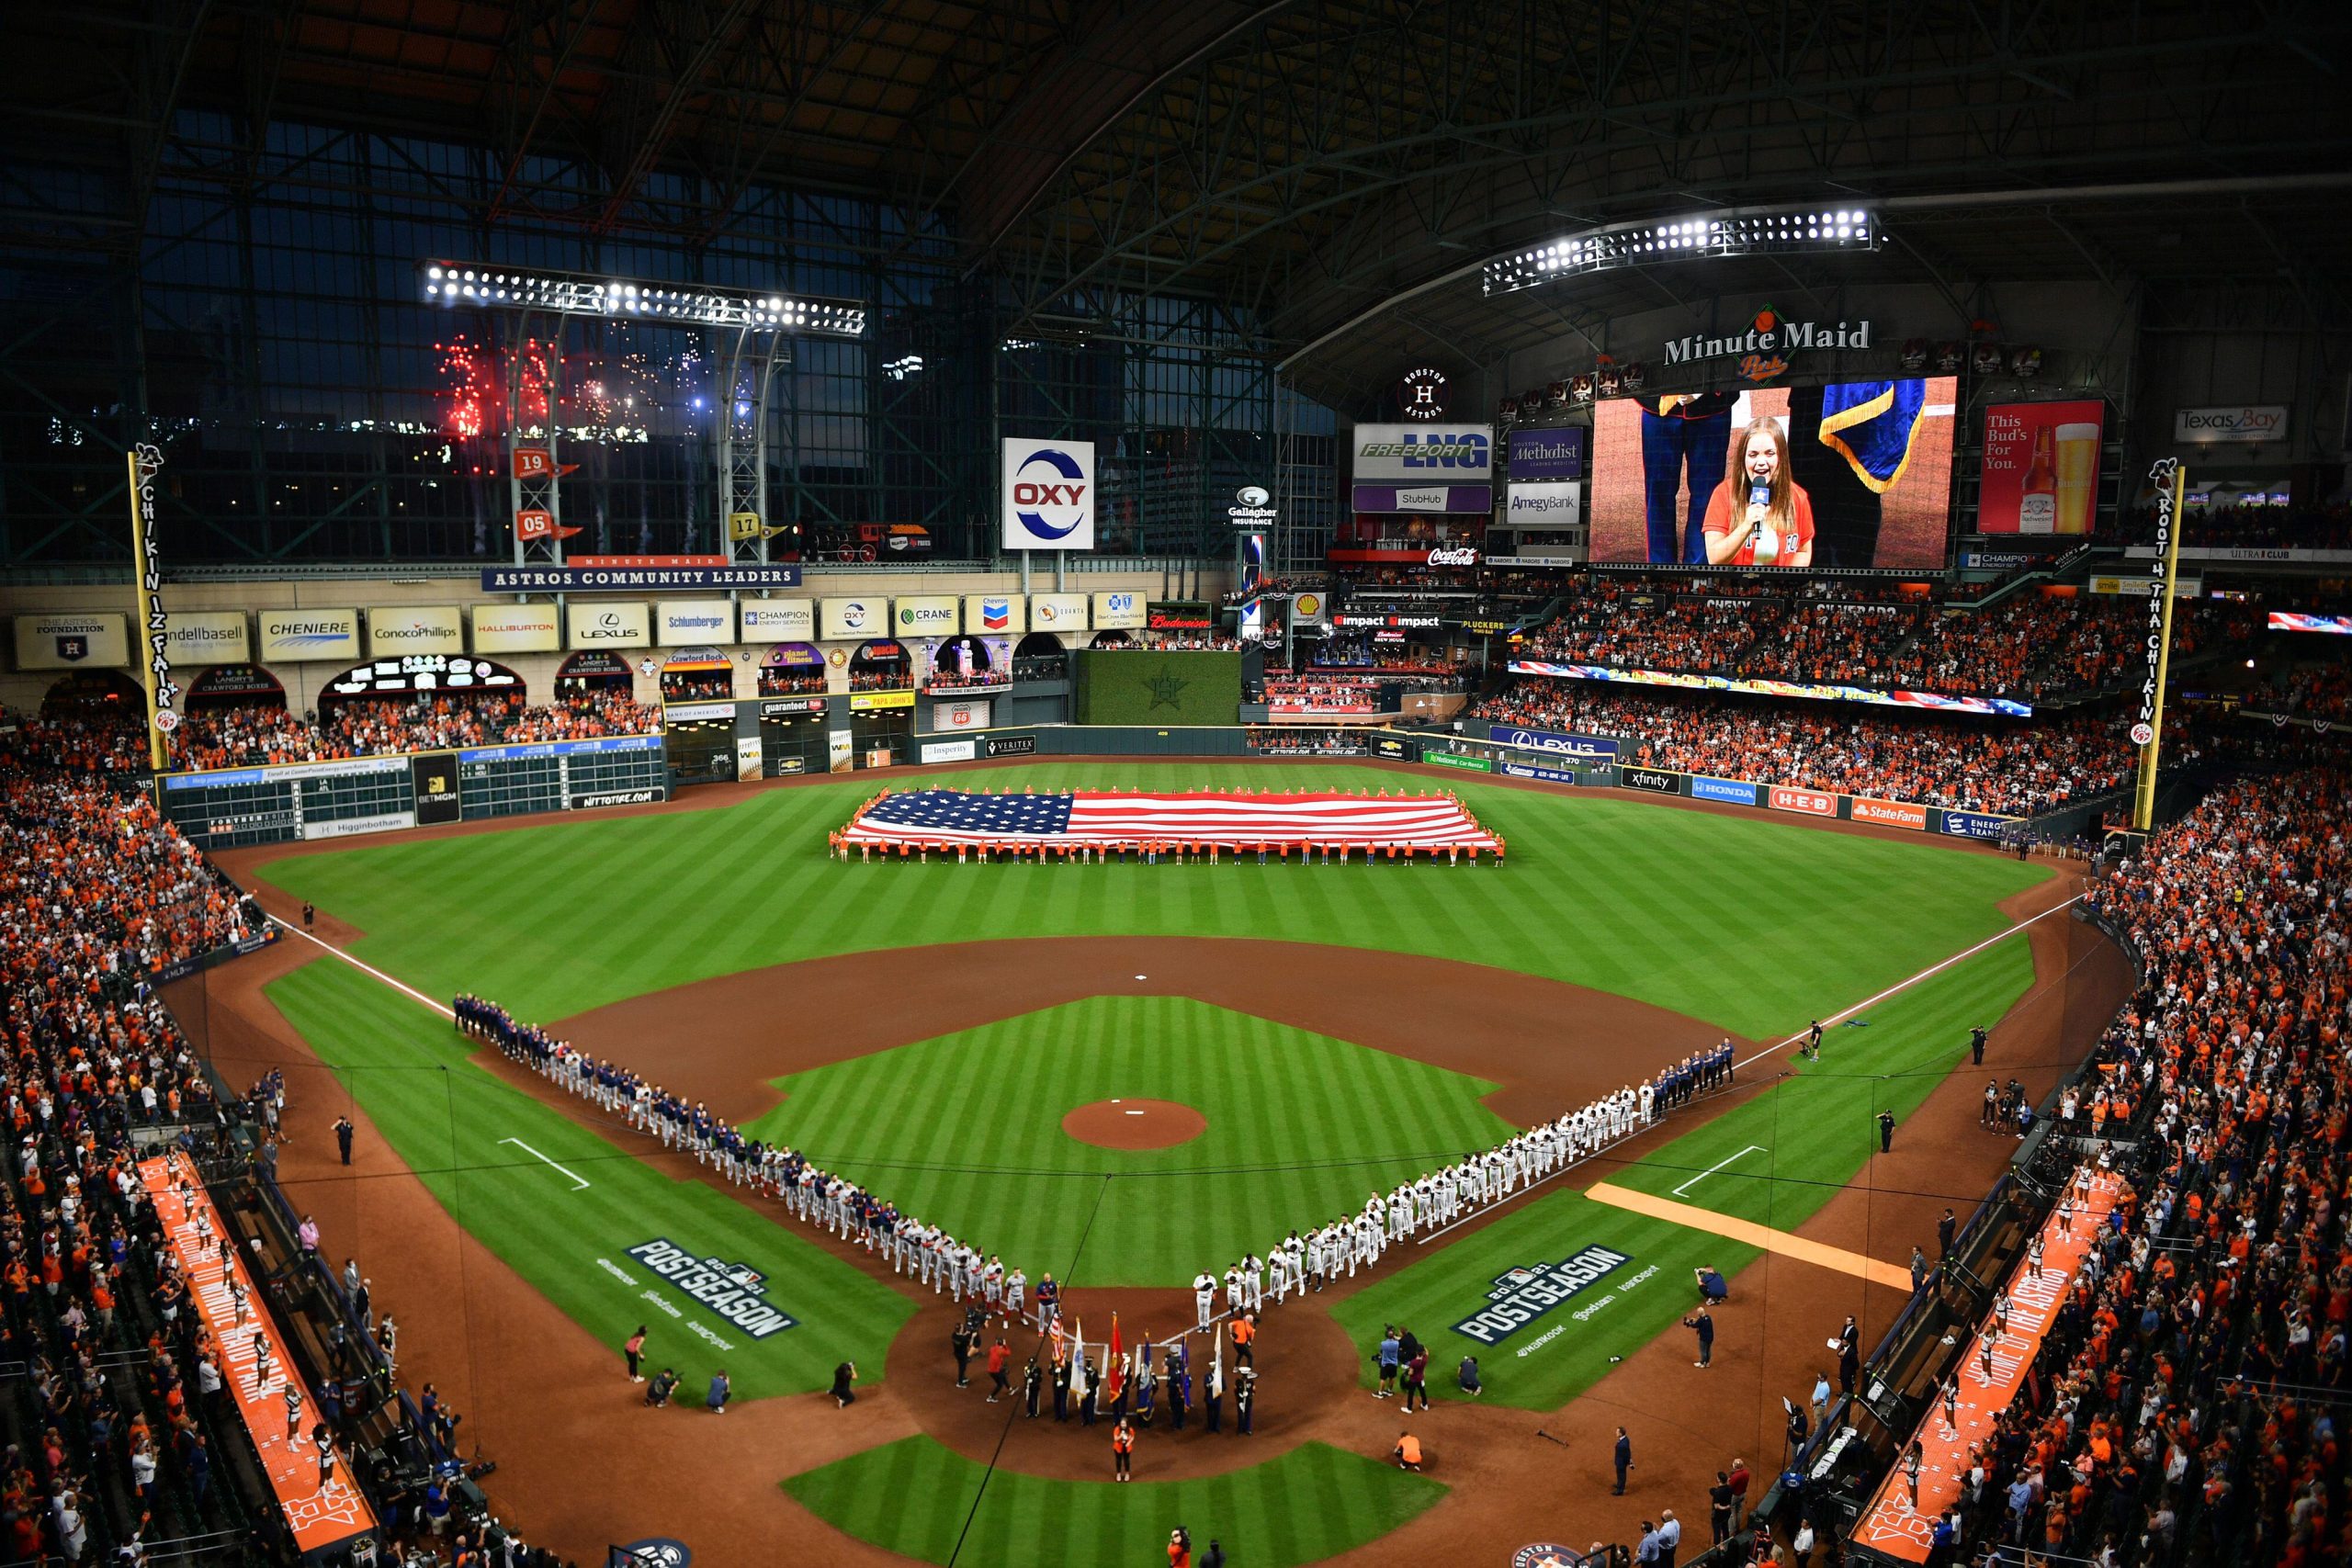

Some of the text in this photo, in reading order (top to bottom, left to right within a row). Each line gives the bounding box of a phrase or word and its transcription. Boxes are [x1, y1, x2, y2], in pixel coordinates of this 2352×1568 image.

[1664, 321, 1871, 367] Minute Maid
[1739, 354, 1788, 382] Park
[1404, 368, 1446, 384] HOUSTON
[1573, 374, 1590, 390] 33
[1415, 386, 1433, 402] H
[1405, 405, 1442, 419] ASTROS
[1988, 414, 2021, 428] This
[2182, 409, 2280, 432] Texas Bay
[1988, 428, 2027, 442] Bud's
[1362, 444, 1472, 457] FREEPORT
[1403, 434, 1488, 468] LNG
[1514, 443, 1577, 460] Methodist
[1986, 443, 2011, 456] For
[523, 456, 542, 469] 19
[1985, 457, 2018, 469] You.
[1013, 483, 1086, 506] OXY
[1402, 494, 1442, 503] StubHub
[1511, 495, 1574, 512] AmegyBank
[1228, 507, 1277, 518] Gallagher
[524, 515, 545, 532] 05
[737, 519, 752, 533] 17
[1982, 554, 2028, 563] CHAMPIO
[494, 570, 792, 586] ASTROS COMMUNITY LEADERS
[141, 485, 160, 591] CHIKIN
[152, 635, 171, 707] FAIR
[1707, 599, 1751, 609] CHEVY
[2140, 498, 2172, 721] ROOT 4 THA CHIKIN
[759, 611, 809, 619] CHAMPION
[916, 610, 952, 619] CRANE
[669, 616, 724, 628] Schlumberger
[1149, 615, 1212, 628] Budweiser
[1342, 616, 1385, 627] impact
[1397, 616, 1440, 628] impact
[1463, 620, 1504, 629] PLUCKERS
[37, 626, 104, 634] FOUNDATION
[270, 622, 350, 635] CHENIERE
[375, 626, 457, 639] ConocoPhillips
[478, 625, 554, 633] HALLIBURTON
[581, 629, 639, 639] LEXUS
[66, 639, 79, 655] H
[872, 644, 899, 655] apache
[672, 653, 723, 662] Crawford Bock
[784, 649, 808, 659] planet
[787, 655, 813, 663] fitness
[889, 696, 911, 705] JOHN'S
[1846, 690, 1888, 702] brave?
[765, 701, 807, 714] guaranteed
[955, 713, 967, 722] 66
[933, 744, 967, 756] Insperity
[998, 739, 1033, 750] VERITEX
[1533, 739, 1595, 753] LEXUS
[1436, 755, 1457, 765] National
[1633, 772, 1669, 790] xfinity
[1704, 784, 1754, 798] HONDA
[418, 792, 457, 804] BETMGM
[583, 791, 652, 807] NITTOTIRE.COM
[337, 818, 401, 831] Higginbotham
[1972, 819, 2001, 830] ENERG
[1972, 828, 1999, 838] TRANS
[705, 1257, 764, 1295] 20 21
[1488, 1263, 1552, 1301] 20 21
[1617, 1264, 1660, 1292] loanDepot
[629, 1239, 792, 1337] POSTSEASON
[1458, 1247, 1626, 1342] POSTSEASON
[2010, 1268, 2069, 1311] ASTROS
[2006, 1308, 2046, 1334] THE
[1516, 1544, 1553, 1567] OUSTON
